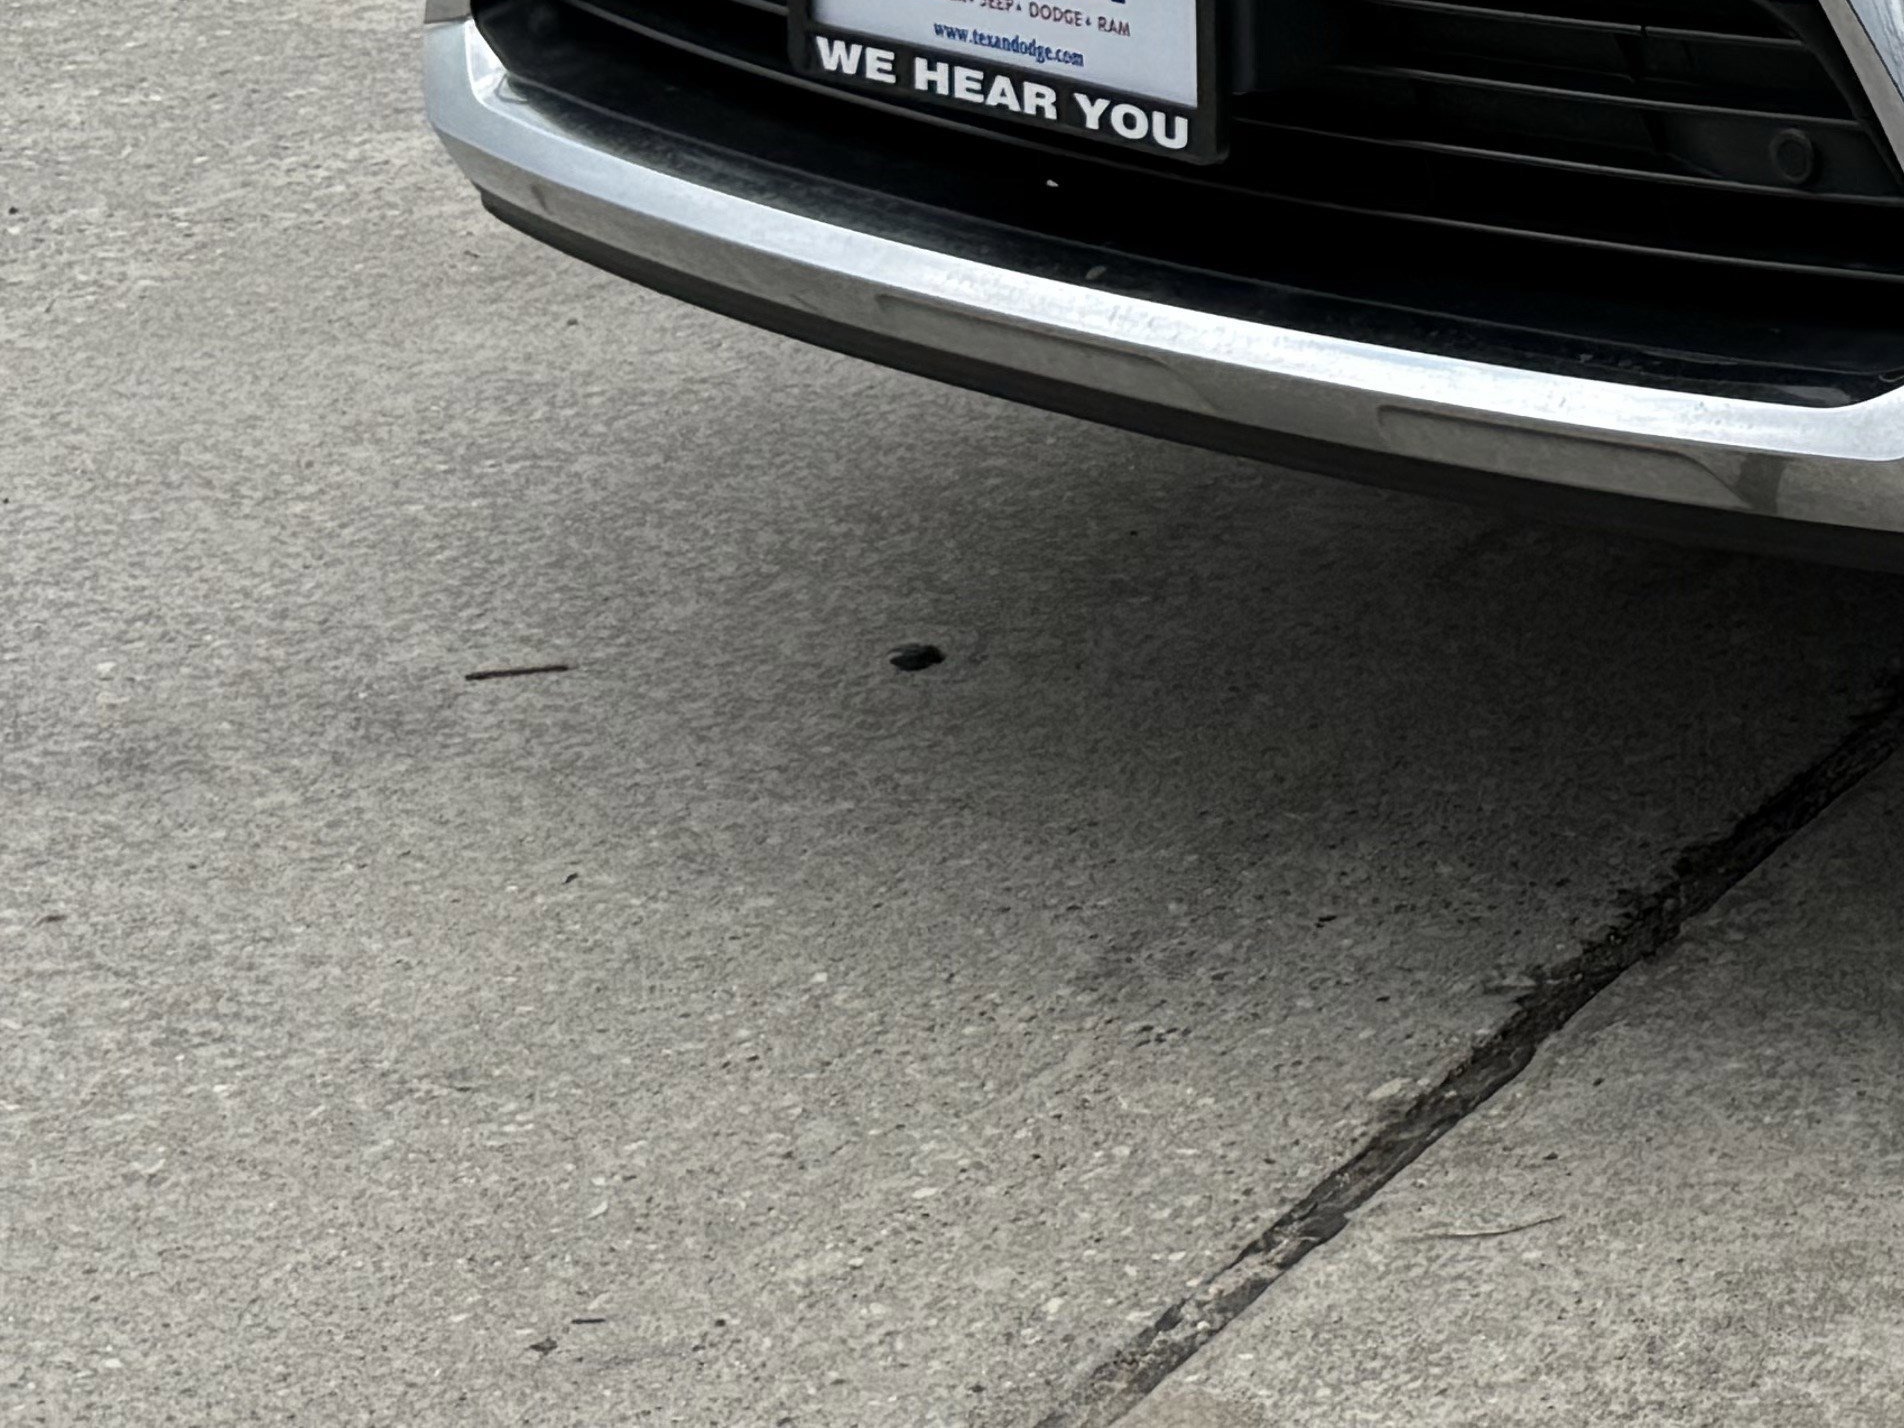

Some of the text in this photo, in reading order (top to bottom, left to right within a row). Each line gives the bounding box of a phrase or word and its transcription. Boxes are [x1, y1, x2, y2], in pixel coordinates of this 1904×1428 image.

[1029, 1, 1083, 28] DODGE
[1097, 16, 1131, 38] RAM
[933, 21, 1085, 68] www.texandodge.com
[815, 35, 1190, 150] WE HEAR YOU
